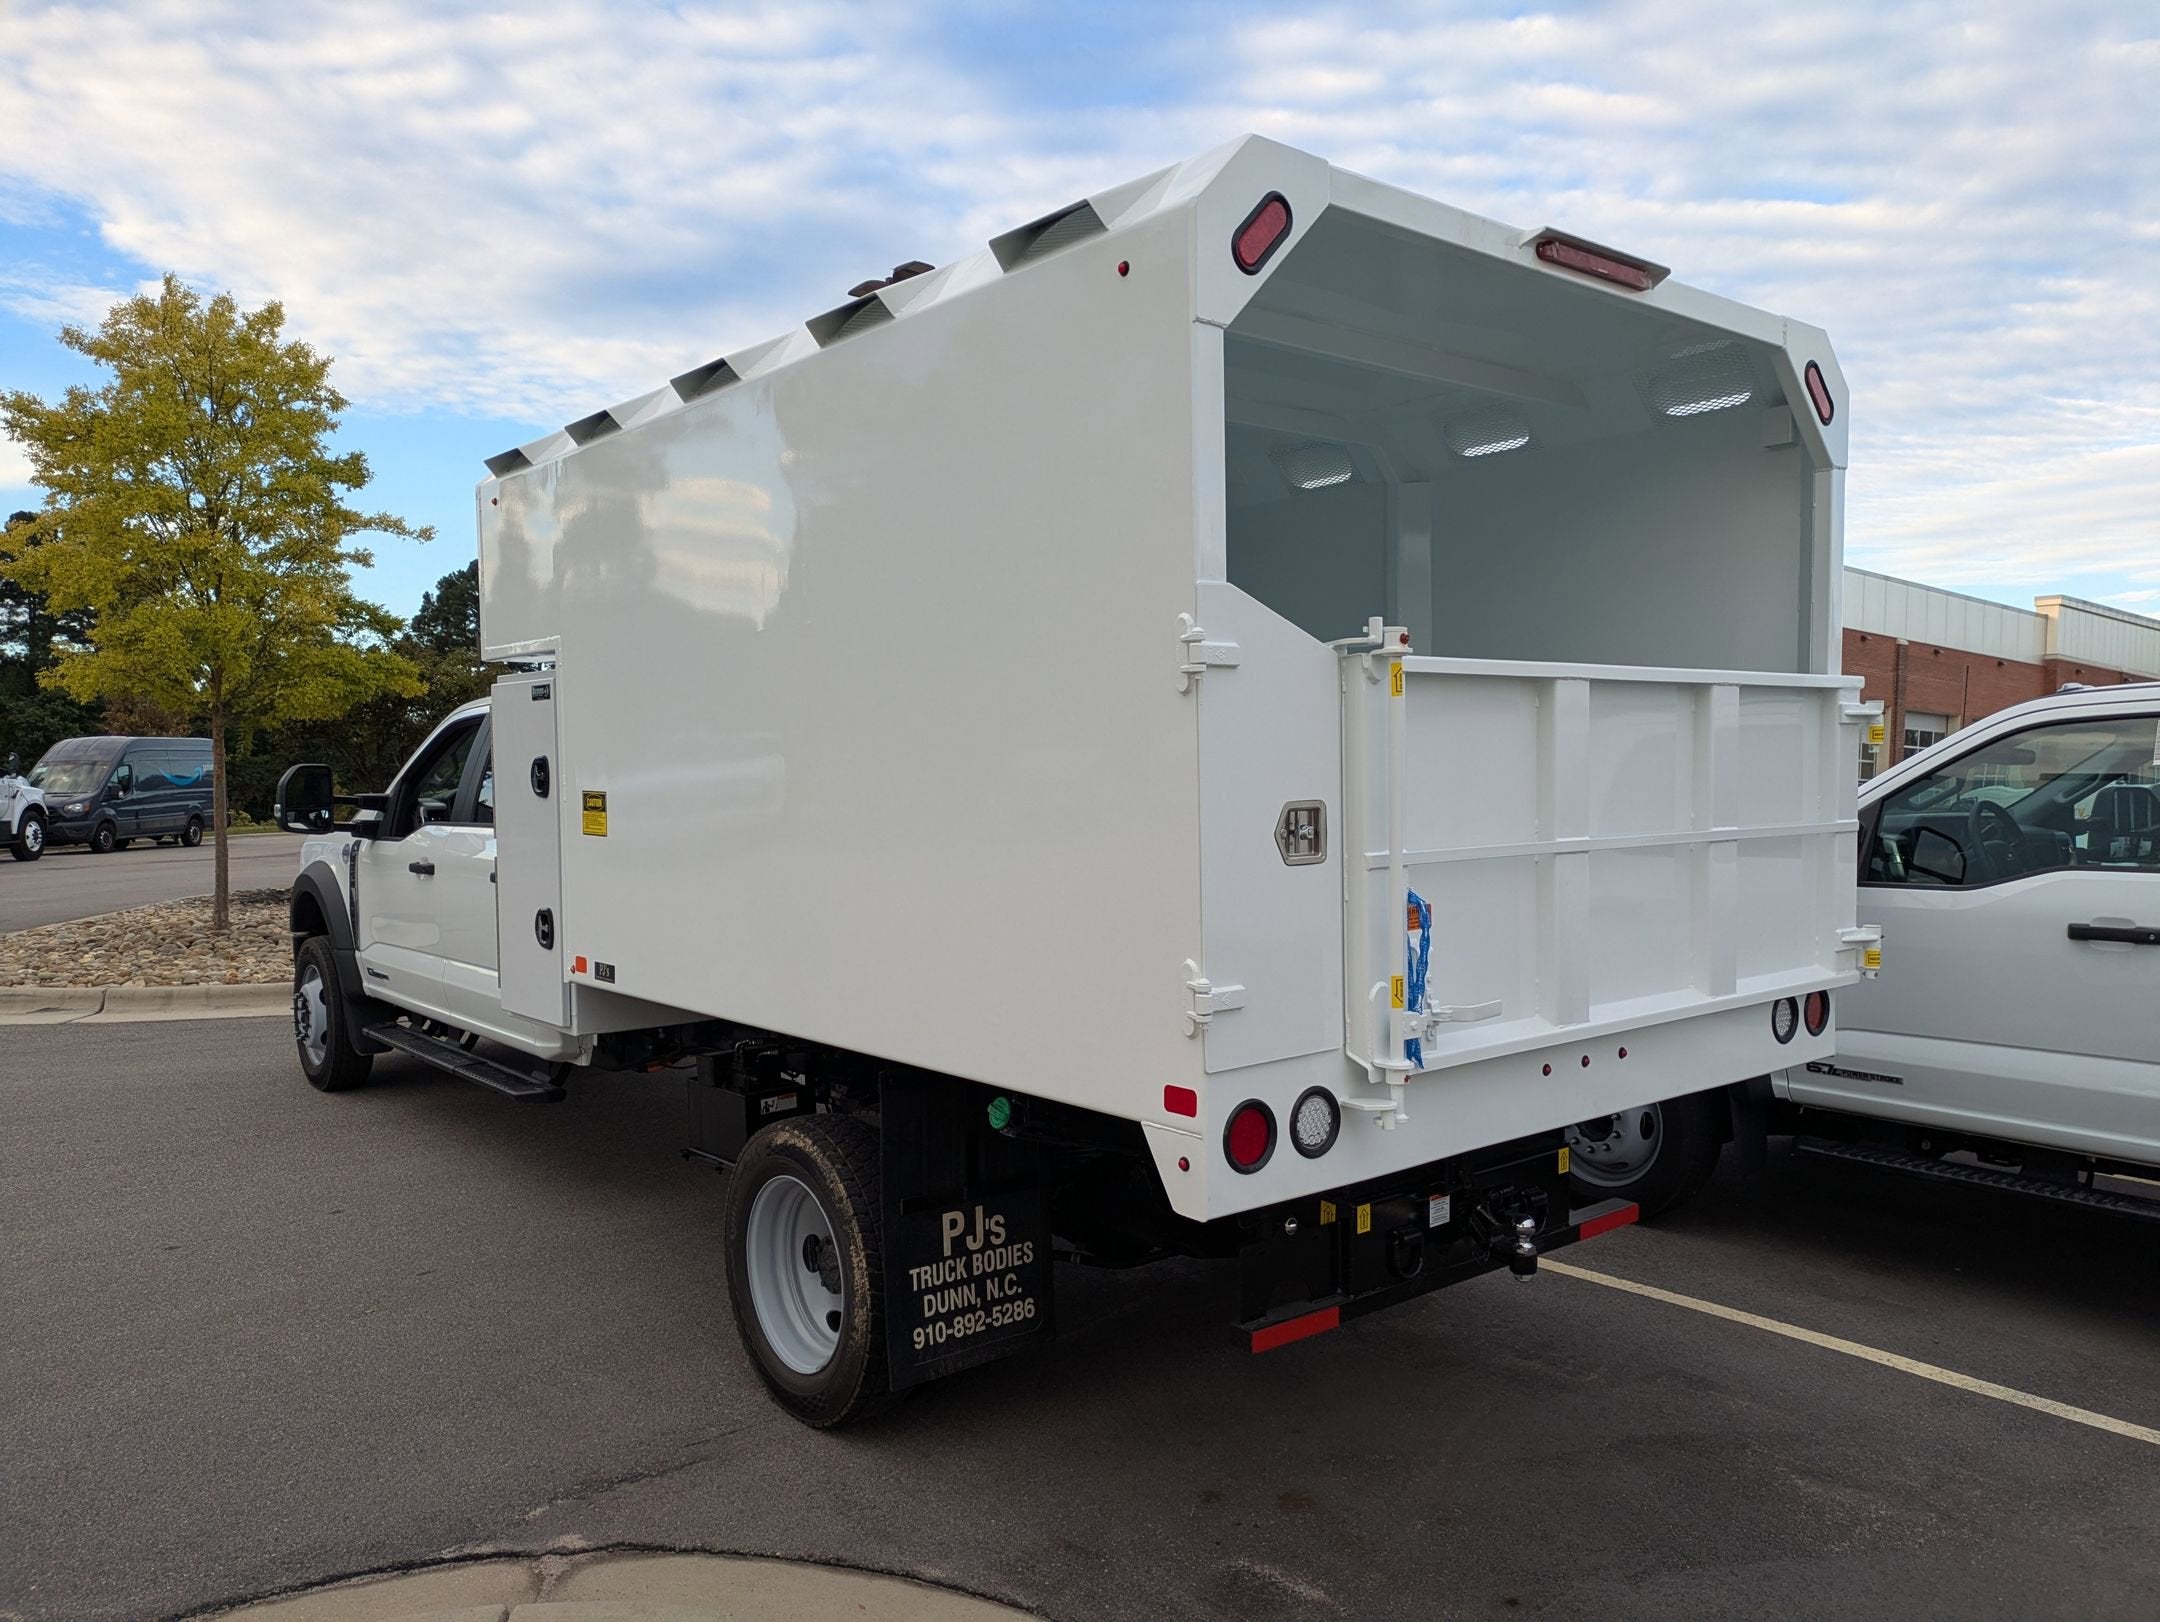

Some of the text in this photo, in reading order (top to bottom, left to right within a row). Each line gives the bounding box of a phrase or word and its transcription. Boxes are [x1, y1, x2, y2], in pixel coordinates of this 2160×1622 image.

[909, 1241, 1033, 1292] TRUCK BODIES
[923, 1273, 1022, 1318] DUNN, N.C.
[913, 1297, 1035, 1350] 910-892-5286
